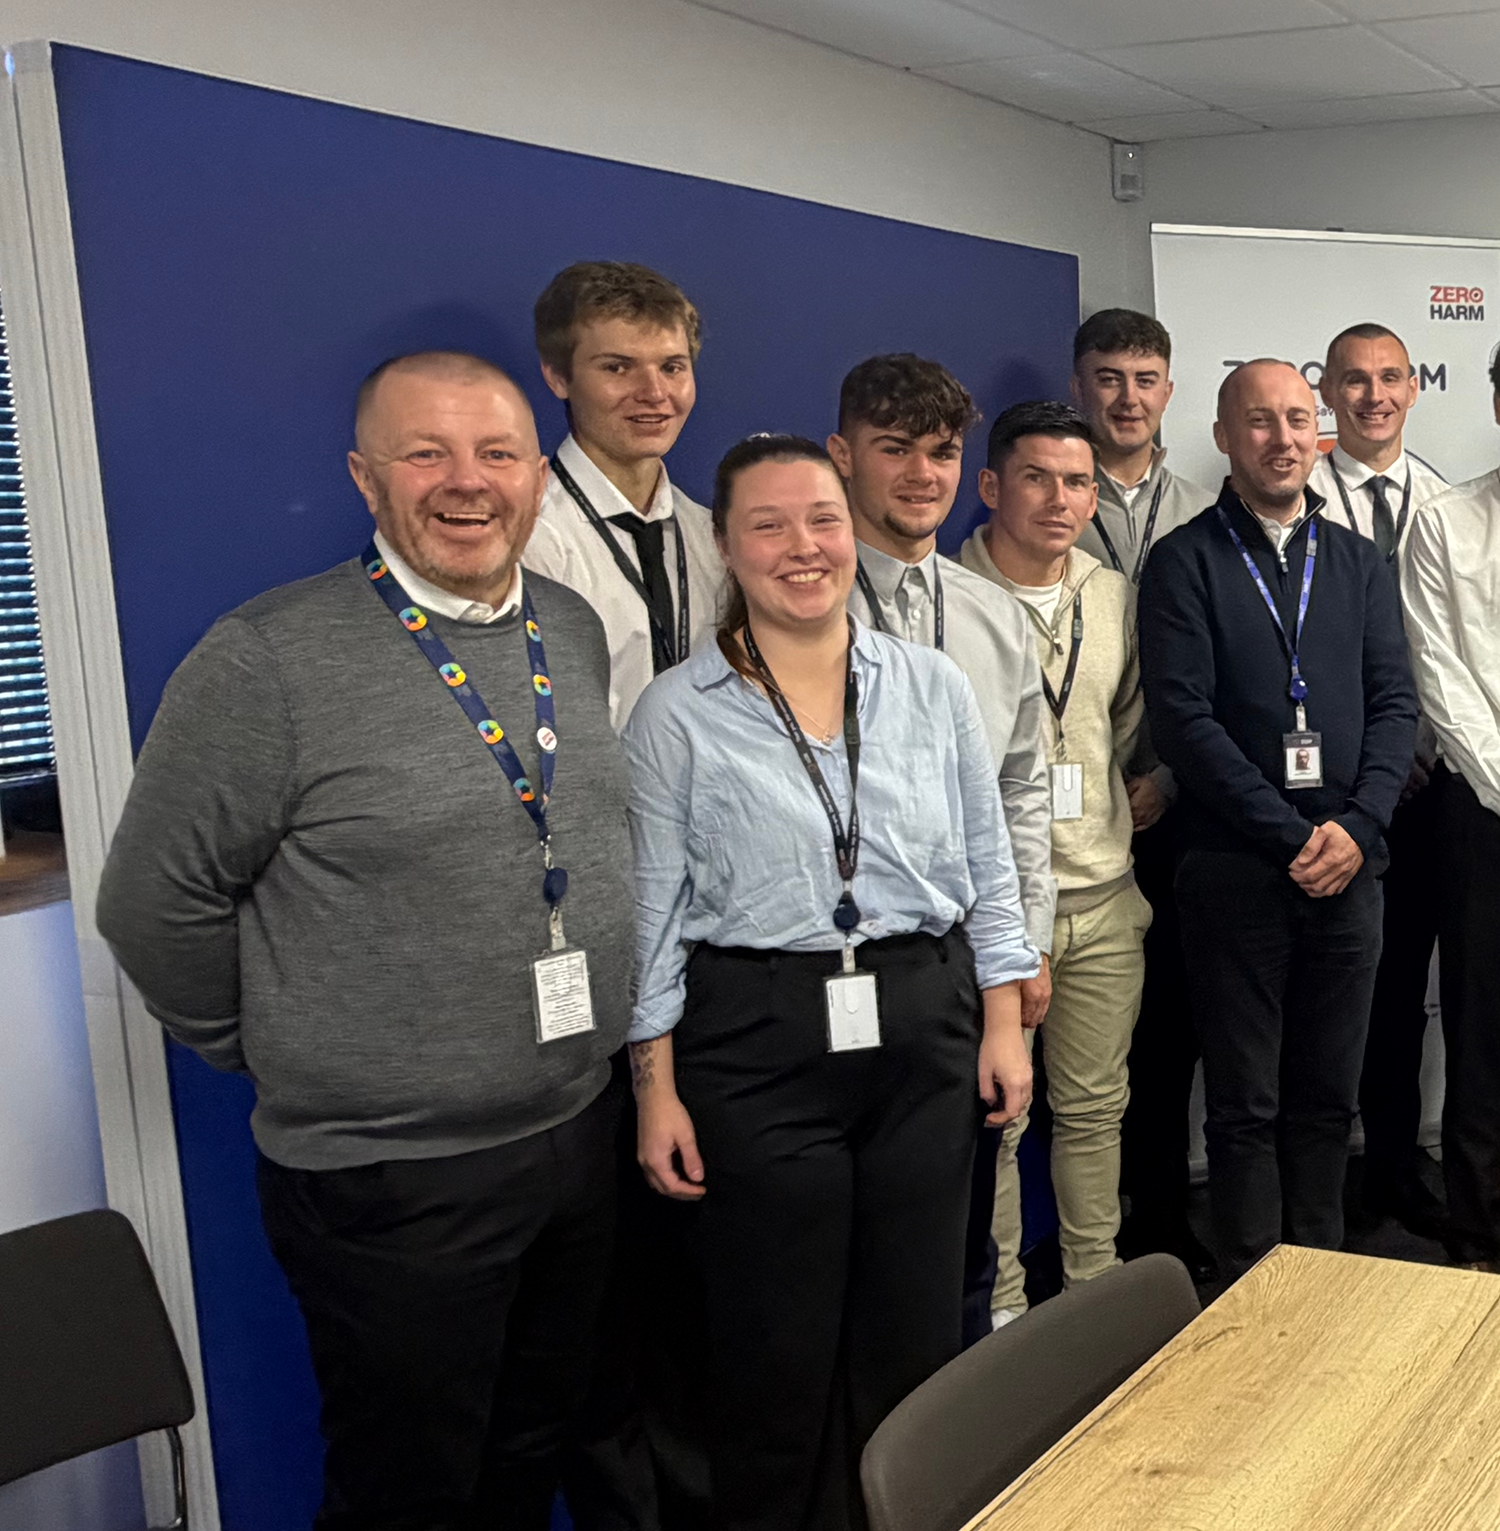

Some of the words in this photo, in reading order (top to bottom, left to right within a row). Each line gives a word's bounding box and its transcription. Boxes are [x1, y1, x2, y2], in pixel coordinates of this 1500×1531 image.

[1430, 286, 1484, 303] ZERO
[1430, 304, 1484, 321] HARM
[1315, 405, 1334, 417] Sav
